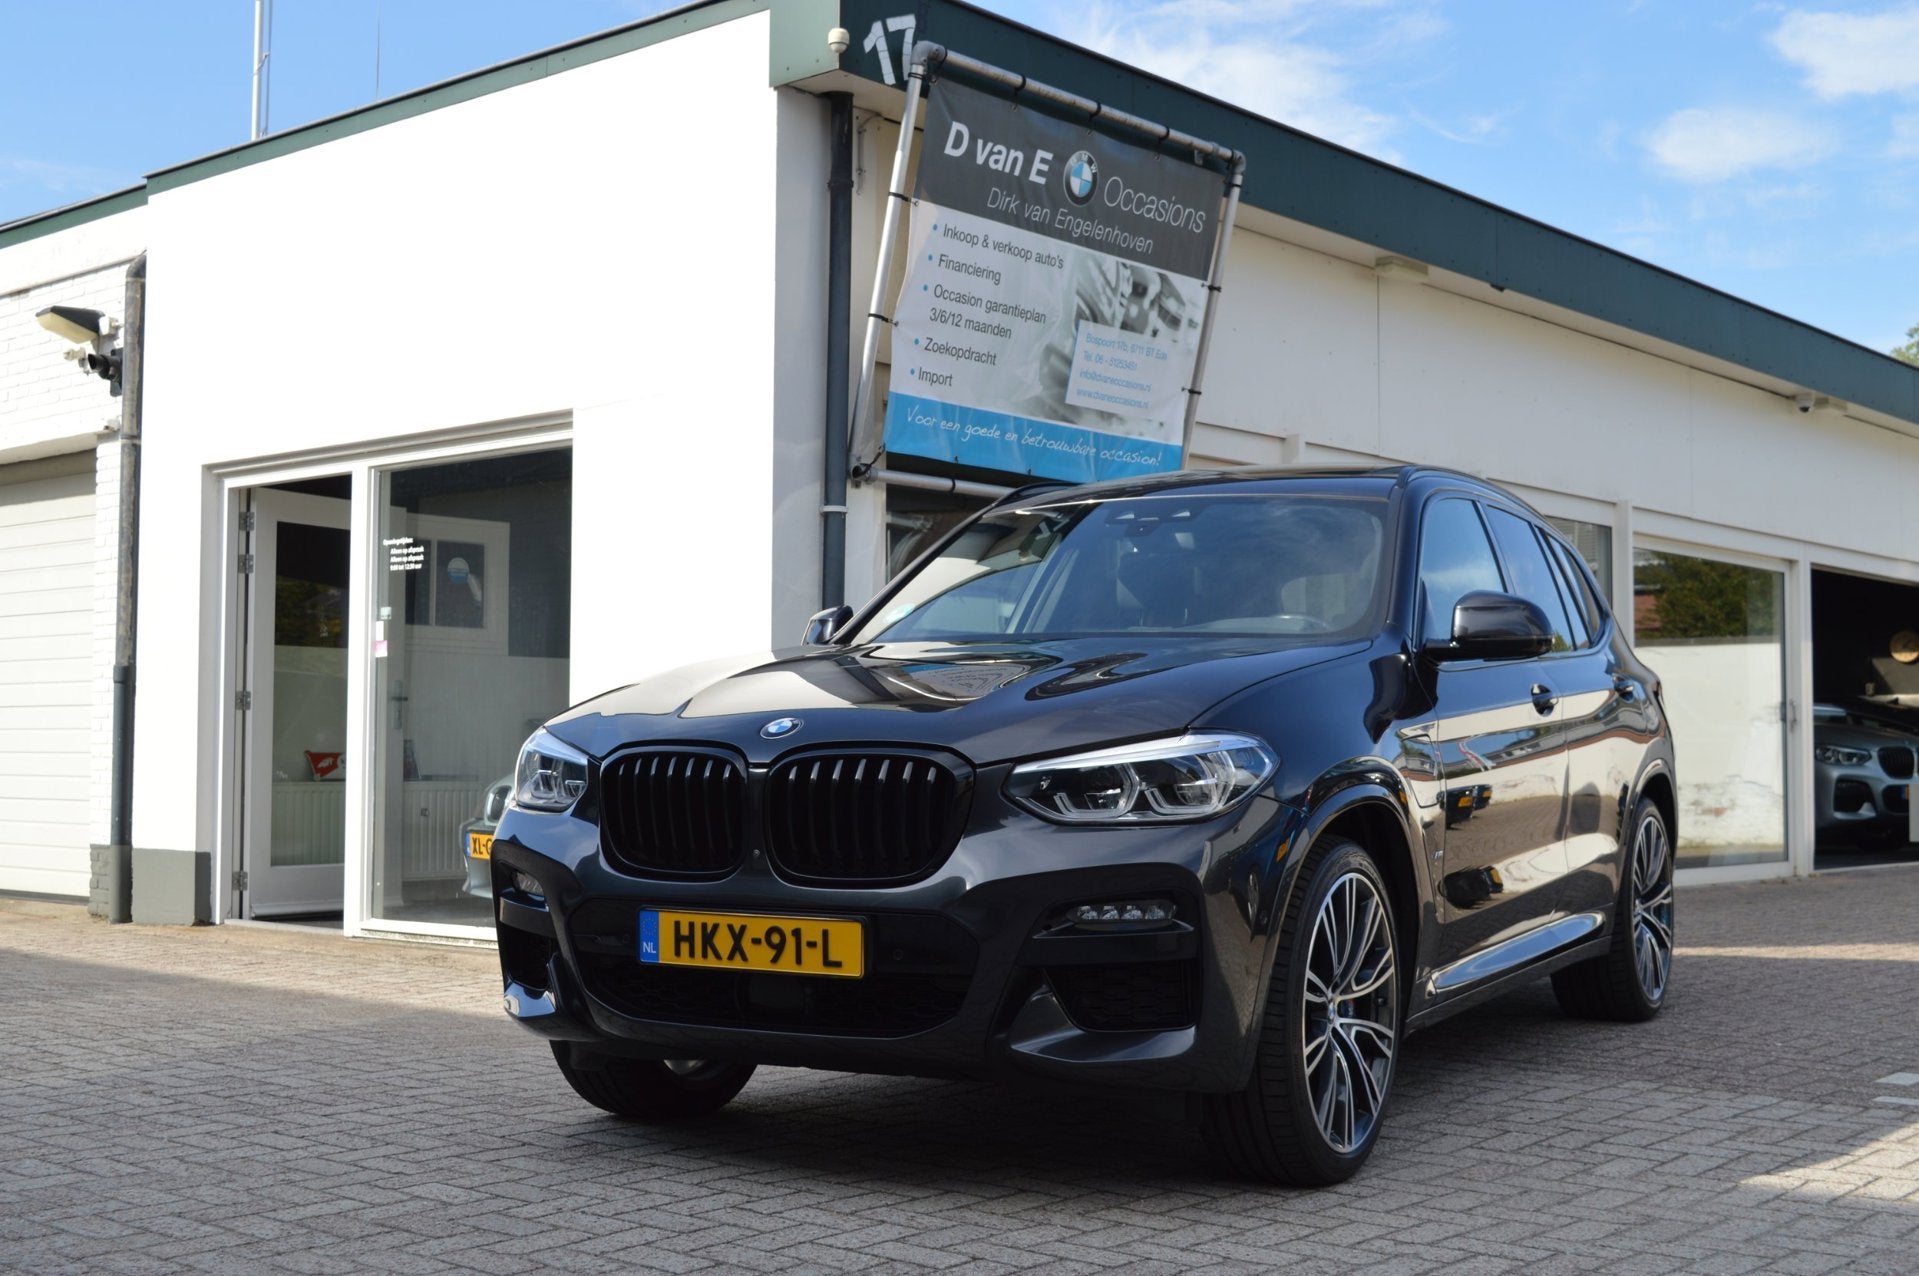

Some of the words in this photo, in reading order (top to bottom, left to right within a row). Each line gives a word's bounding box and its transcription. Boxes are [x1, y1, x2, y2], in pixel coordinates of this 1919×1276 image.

[863, 14, 916, 85] 17
[944, 121, 969, 158] D
[976, 138, 1024, 178] van
[1029, 148, 1053, 185] E
[1104, 176, 1206, 233] Occasions
[986, 187, 1020, 217] Dirk
[1024, 202, 1050, 226] van
[1054, 209, 1154, 255] Engelenhoven
[942, 223, 979, 249] Inkoop
[981, 233, 990, 248] &
[992, 240, 1033, 267] verkoop
[1035, 250, 1064, 270] auto's
[938, 254, 1002, 285] Financiering
[929, 307, 961, 328] 3/6/12
[964, 317, 1012, 340] maanden
[933, 284, 983, 312] Occasion
[985, 298, 1046, 324] garantieplan
[924, 338, 997, 366] Zoekopdracht
[918, 367, 953, 387] Import
[907, 404, 937, 427] Voor
[940, 420, 961, 433] een
[962, 419, 1000, 442] goede
[1005, 431, 1018, 442] en
[1021, 428, 1097, 457] betrouwbare
[1100, 448, 1163, 466] occasion!
[643, 942, 657, 954] NL
[674, 920, 842, 968] HKX-91-L
